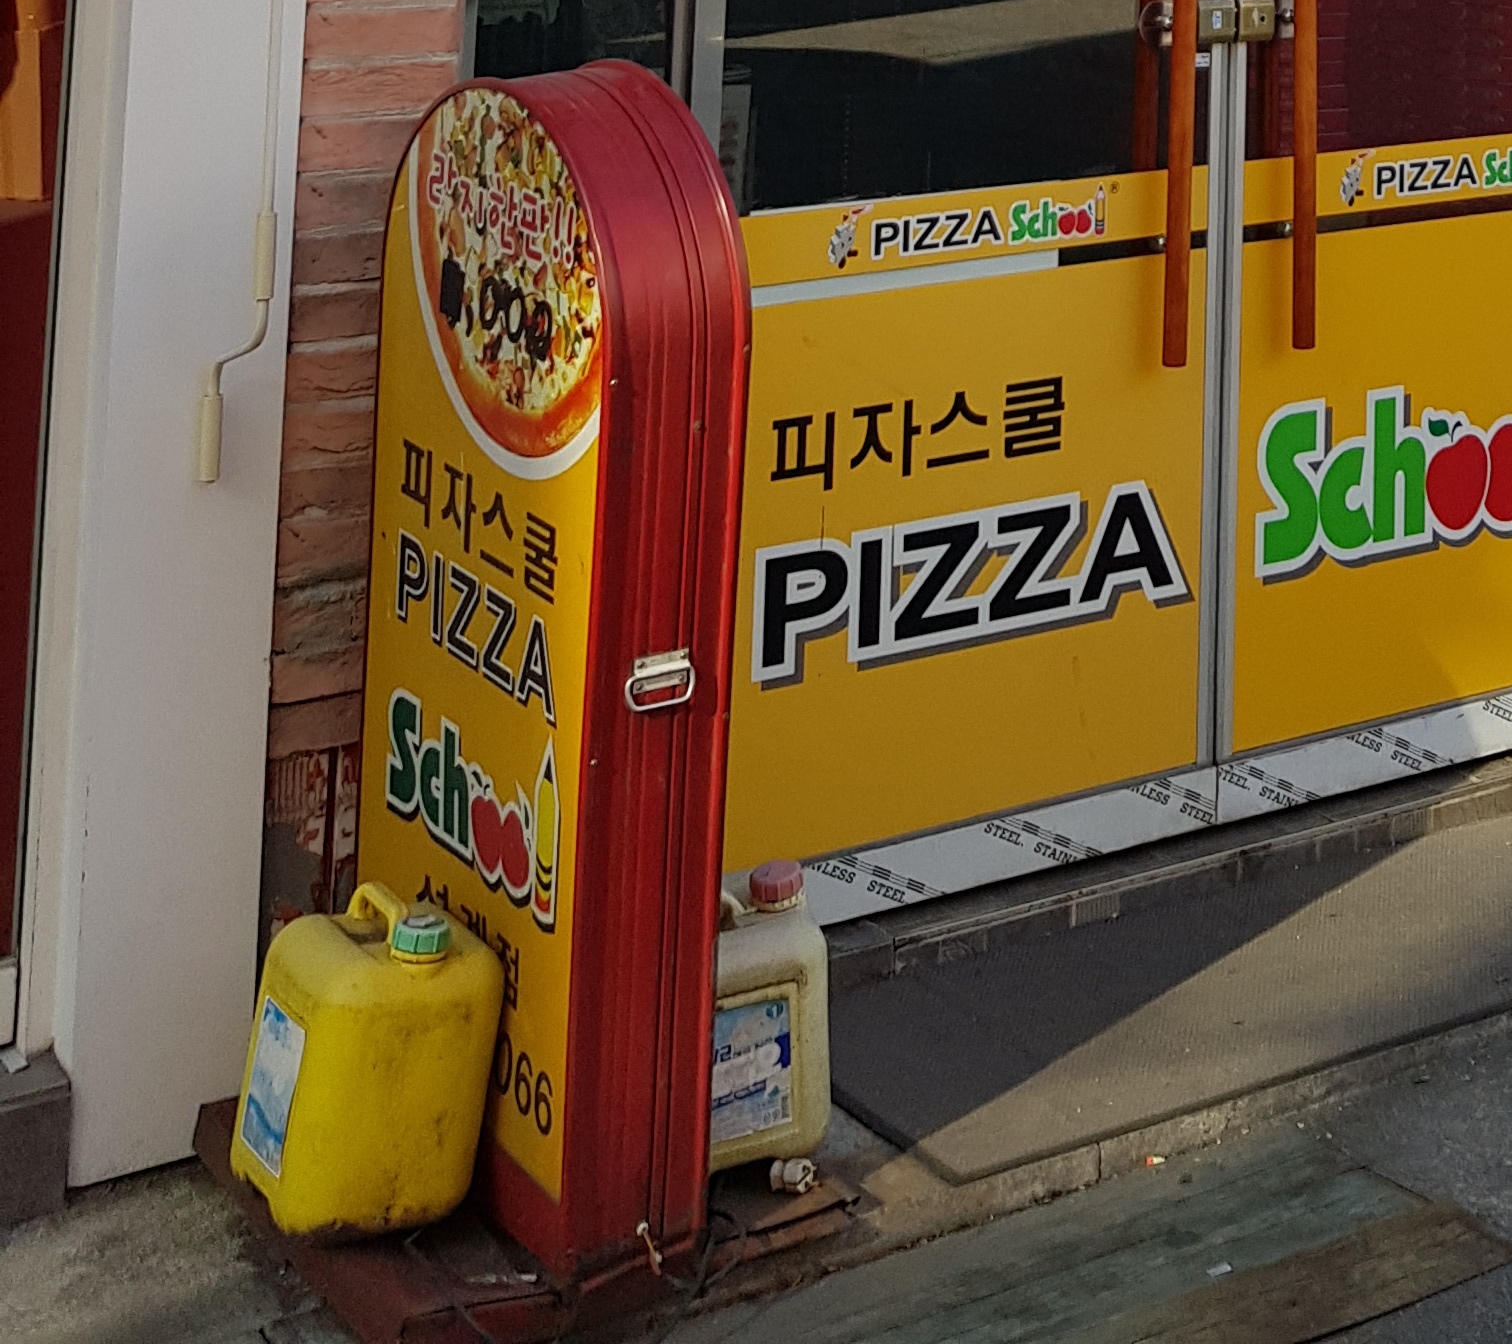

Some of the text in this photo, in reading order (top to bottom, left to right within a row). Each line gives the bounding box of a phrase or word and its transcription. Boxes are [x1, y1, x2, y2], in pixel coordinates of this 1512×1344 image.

[871, 183, 1113, 262] PIZZA School
[1372, 156, 1480, 200] PIZZA
[770, 375, 1067, 491] 피자스쿨
[401, 439, 558, 605] 피자스쿨
[752, 480, 1194, 686] PIZZA
[398, 528, 557, 728] PIZZA
[385, 687, 561, 934] School
